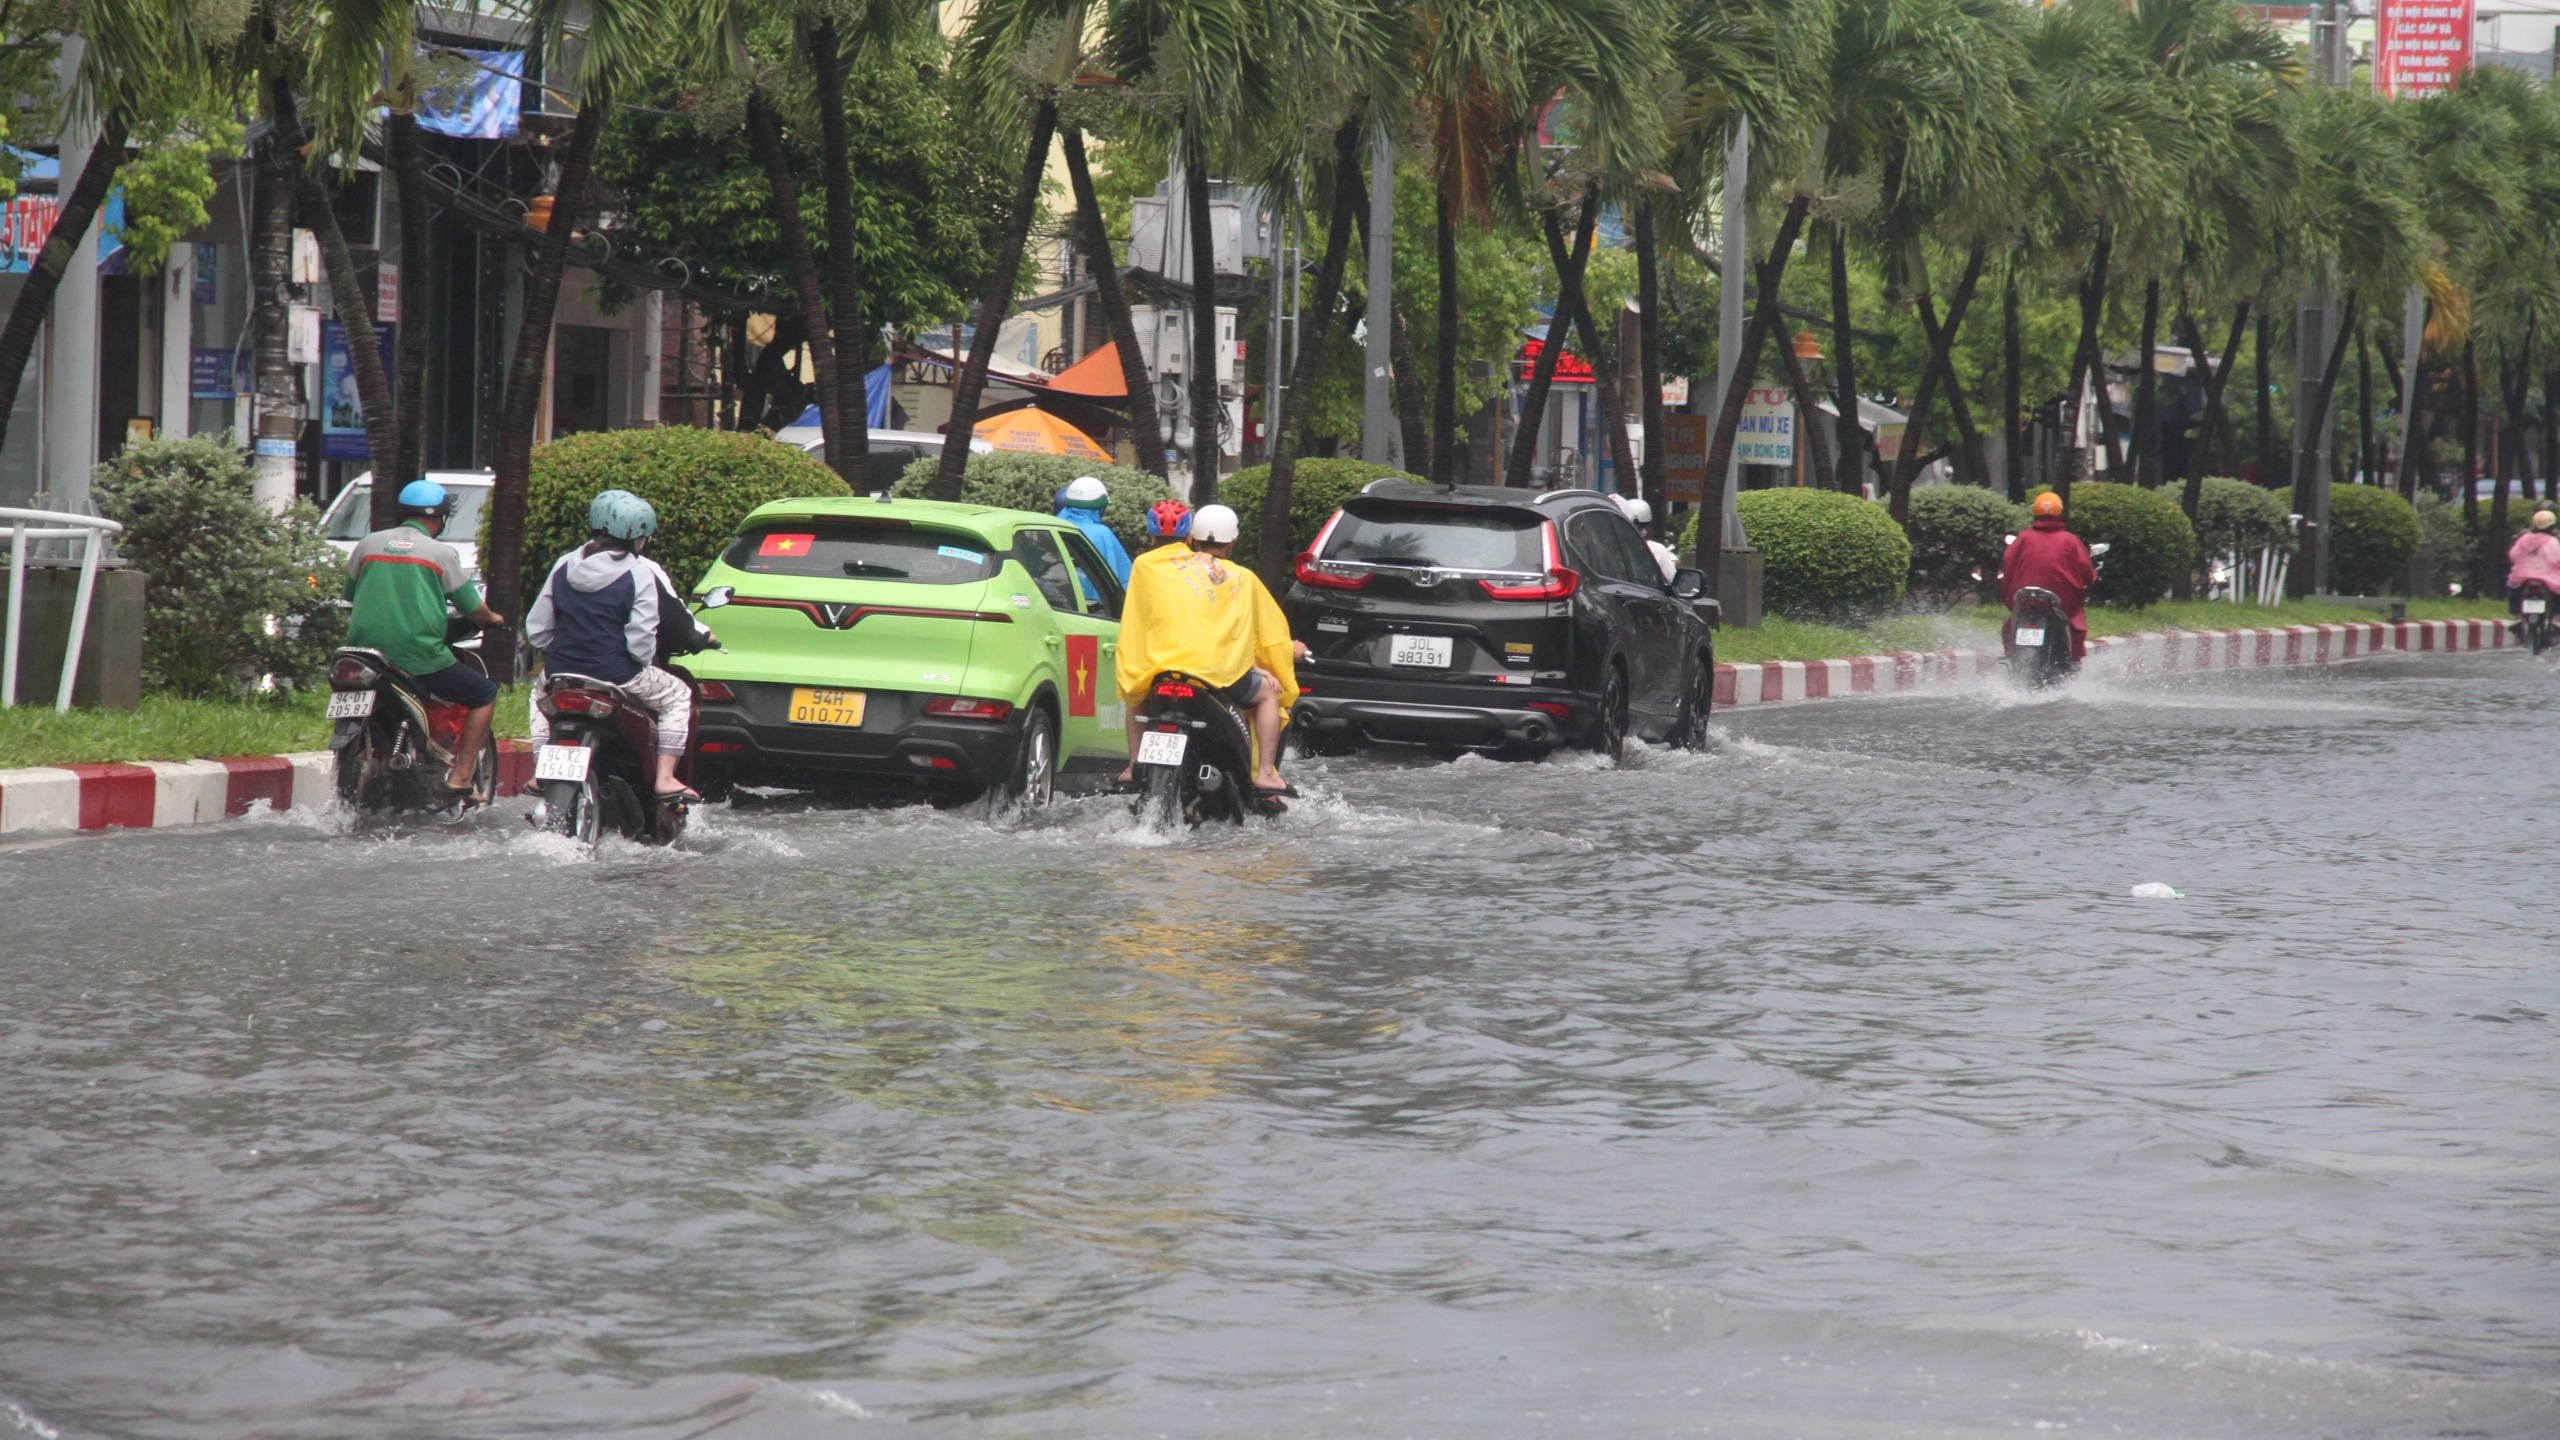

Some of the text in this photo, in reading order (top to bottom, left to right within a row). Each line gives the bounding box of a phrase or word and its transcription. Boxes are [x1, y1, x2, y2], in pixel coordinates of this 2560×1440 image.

[1776, 416, 1790, 434] XE
[1409, 637, 1434, 650] 30L
[1397, 651, 1442, 665] 983.91
[812, 690, 844, 706] 94H
[328, 704, 369, 717] 205.82
[797, 706, 854, 723] 010.77
[1149, 735, 1179, 749] 94-AB
[547, 749, 581, 763] 94-K2
[1143, 748, 1181, 763] 145.25
[542, 763, 584, 778] 154.03
